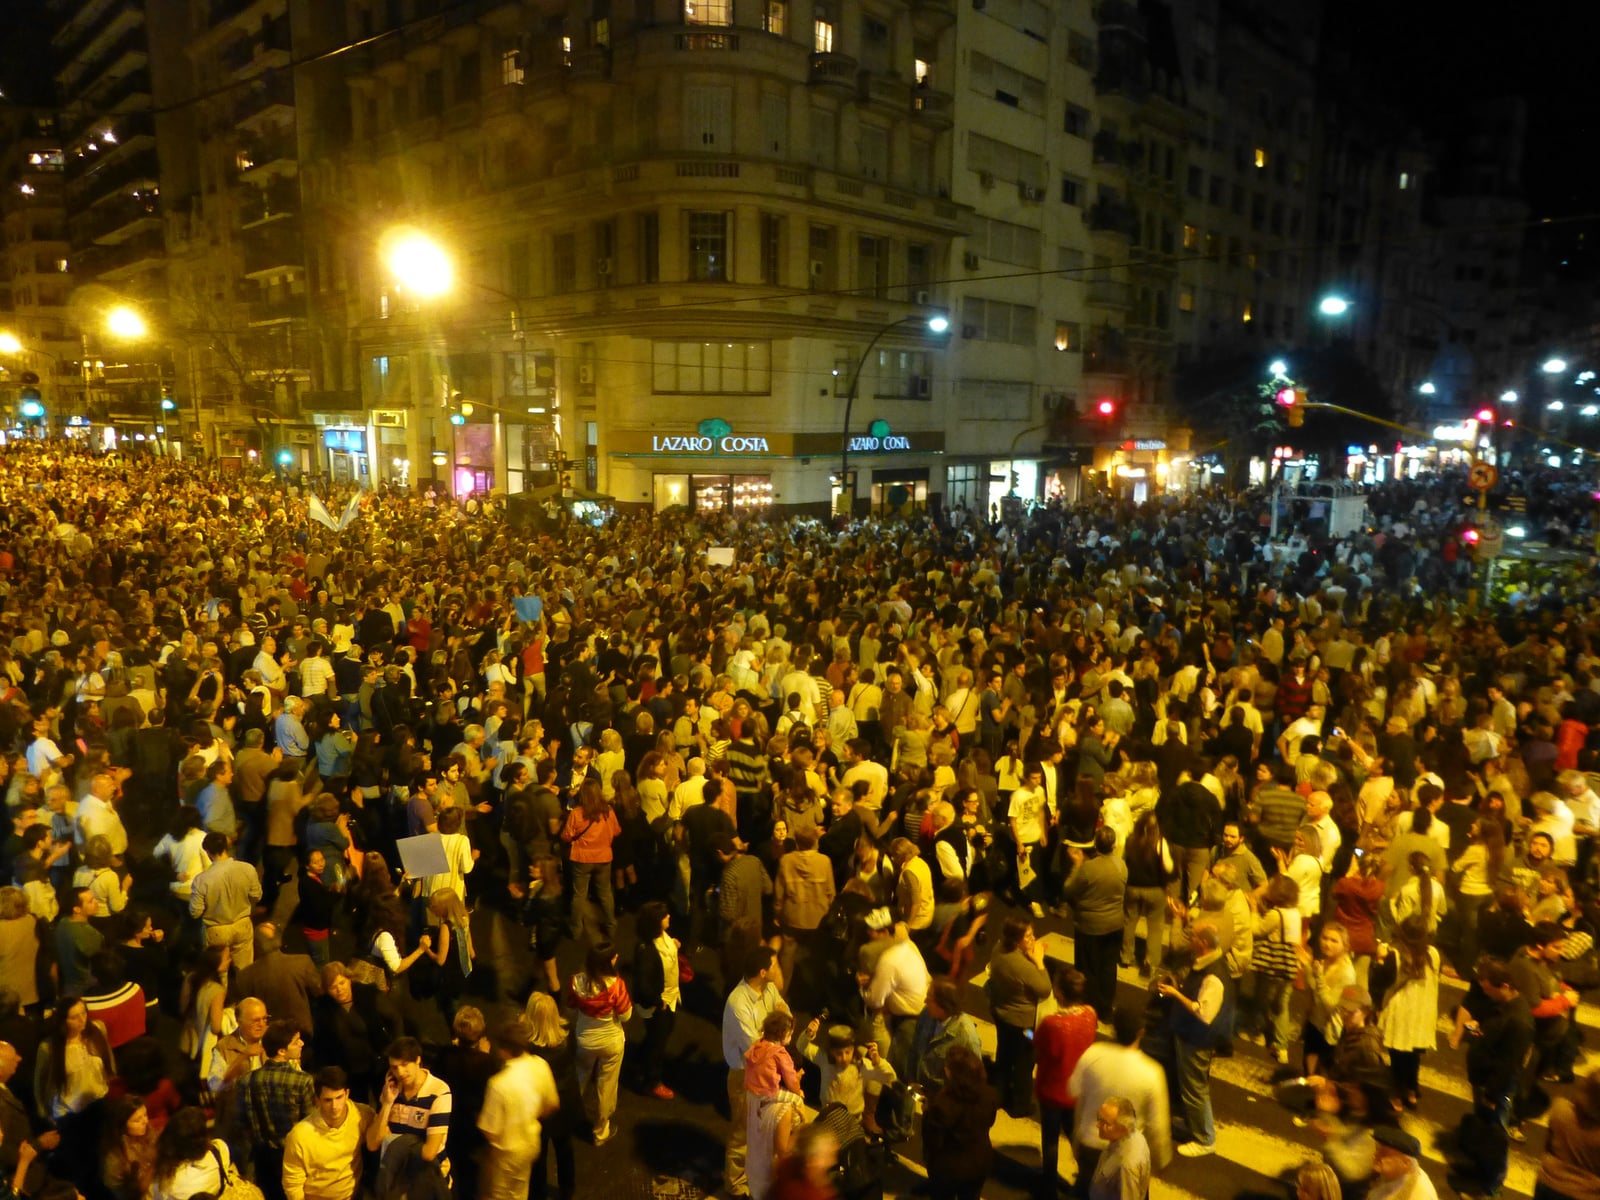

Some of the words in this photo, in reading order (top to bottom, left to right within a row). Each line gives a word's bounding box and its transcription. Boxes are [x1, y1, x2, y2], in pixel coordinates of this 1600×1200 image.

[652, 435, 713, 452] LAZARO
[721, 436, 769, 452] COSTA
[847, 436, 880, 452] AZARO
[882, 436, 911, 451] COSTA
